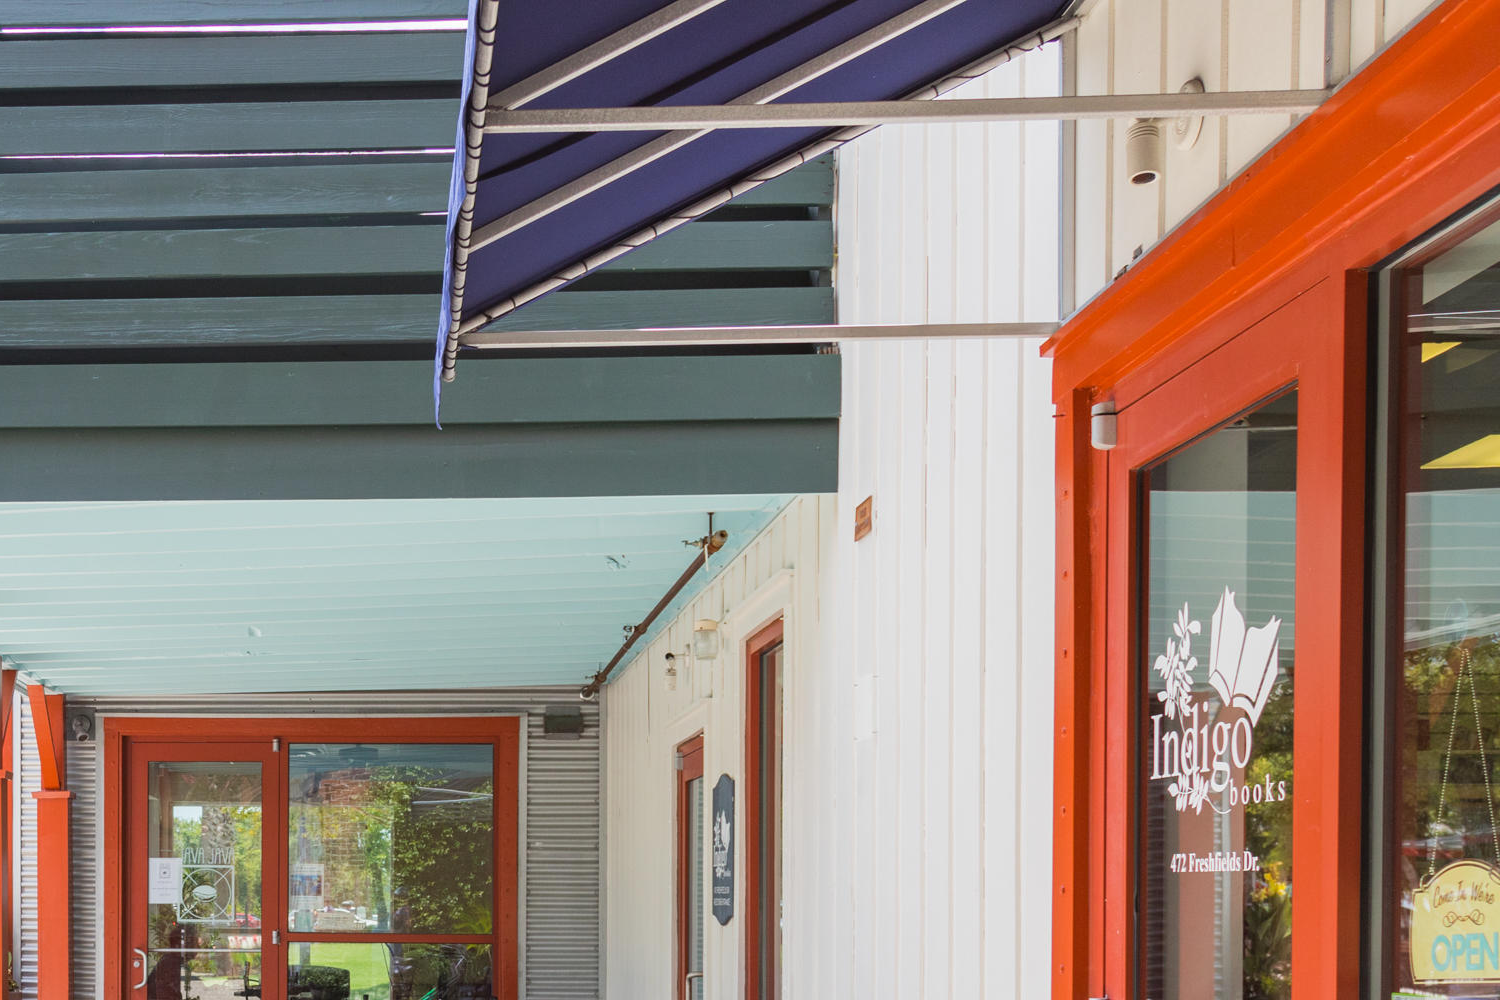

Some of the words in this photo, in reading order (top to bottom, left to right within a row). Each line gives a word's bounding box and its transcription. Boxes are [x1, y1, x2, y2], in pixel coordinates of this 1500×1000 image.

[1150, 702, 1253, 792] Indigo
[1229, 773, 1286, 806] books
[1170, 852, 1188, 873] 472
[1188, 851, 1241, 873] Freshfields
[1243, 849, 1261, 873] Dr.
[1431, 931, 1499, 972] OPEN
